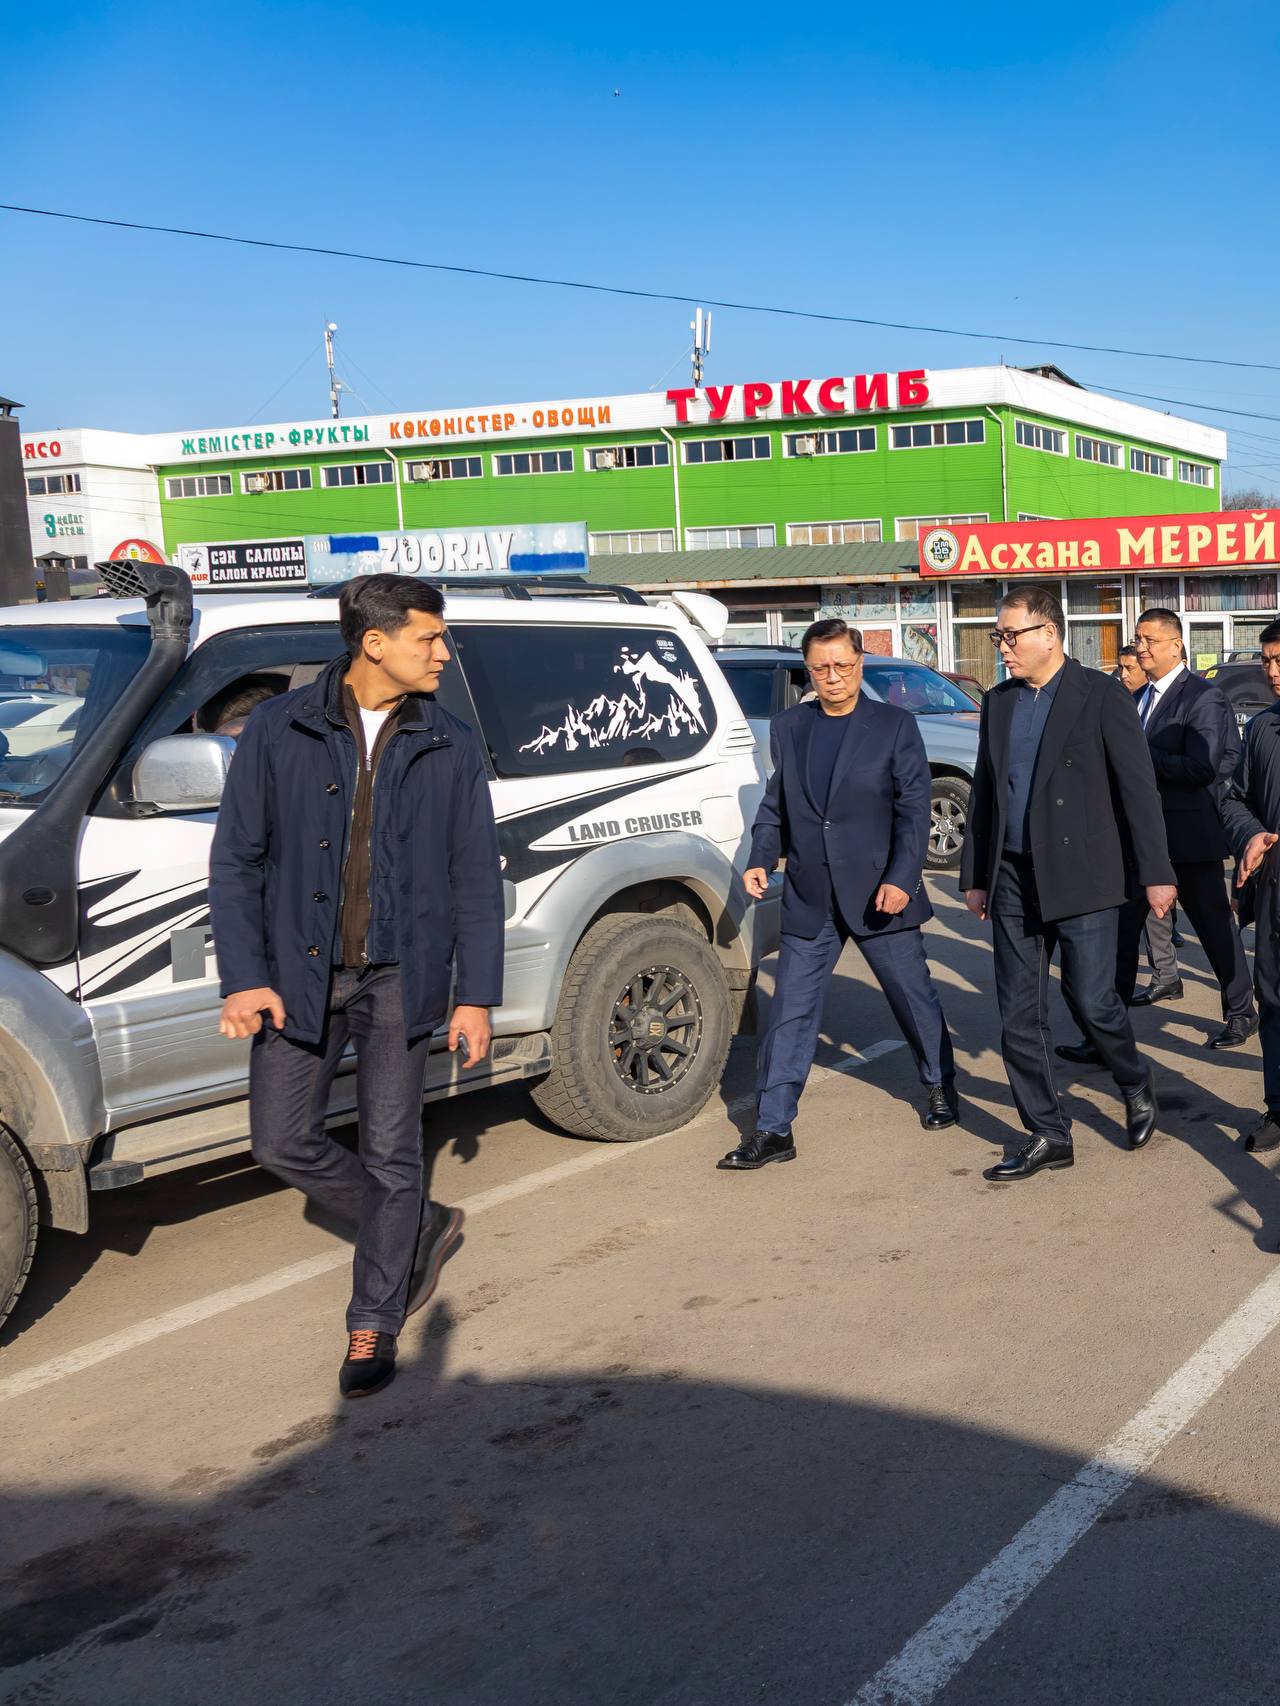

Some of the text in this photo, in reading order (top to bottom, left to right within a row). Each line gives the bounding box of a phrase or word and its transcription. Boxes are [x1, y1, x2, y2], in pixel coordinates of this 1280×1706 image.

[666, 370, 929, 423] ТУРКСИБ
[389, 405, 611, 439] КӨКӨНІСТЕР ОВОЩИ
[22, 441, 61, 459] ЯСО
[181, 424, 370, 455] ЖЕМІСТЕР ФРУКТЫ
[245, 546, 304, 563] САЛОНЫ
[379, 532, 514, 573] ZOORAY
[959, 534, 1101, 571] Асхана
[1116, 512, 1276, 566] МЕРЕЙ
[189, 573, 208, 581] AUR
[212, 565, 305, 581] САЛОН КРАСОТЫ
[568, 810, 702, 843] LAND CRUISER
